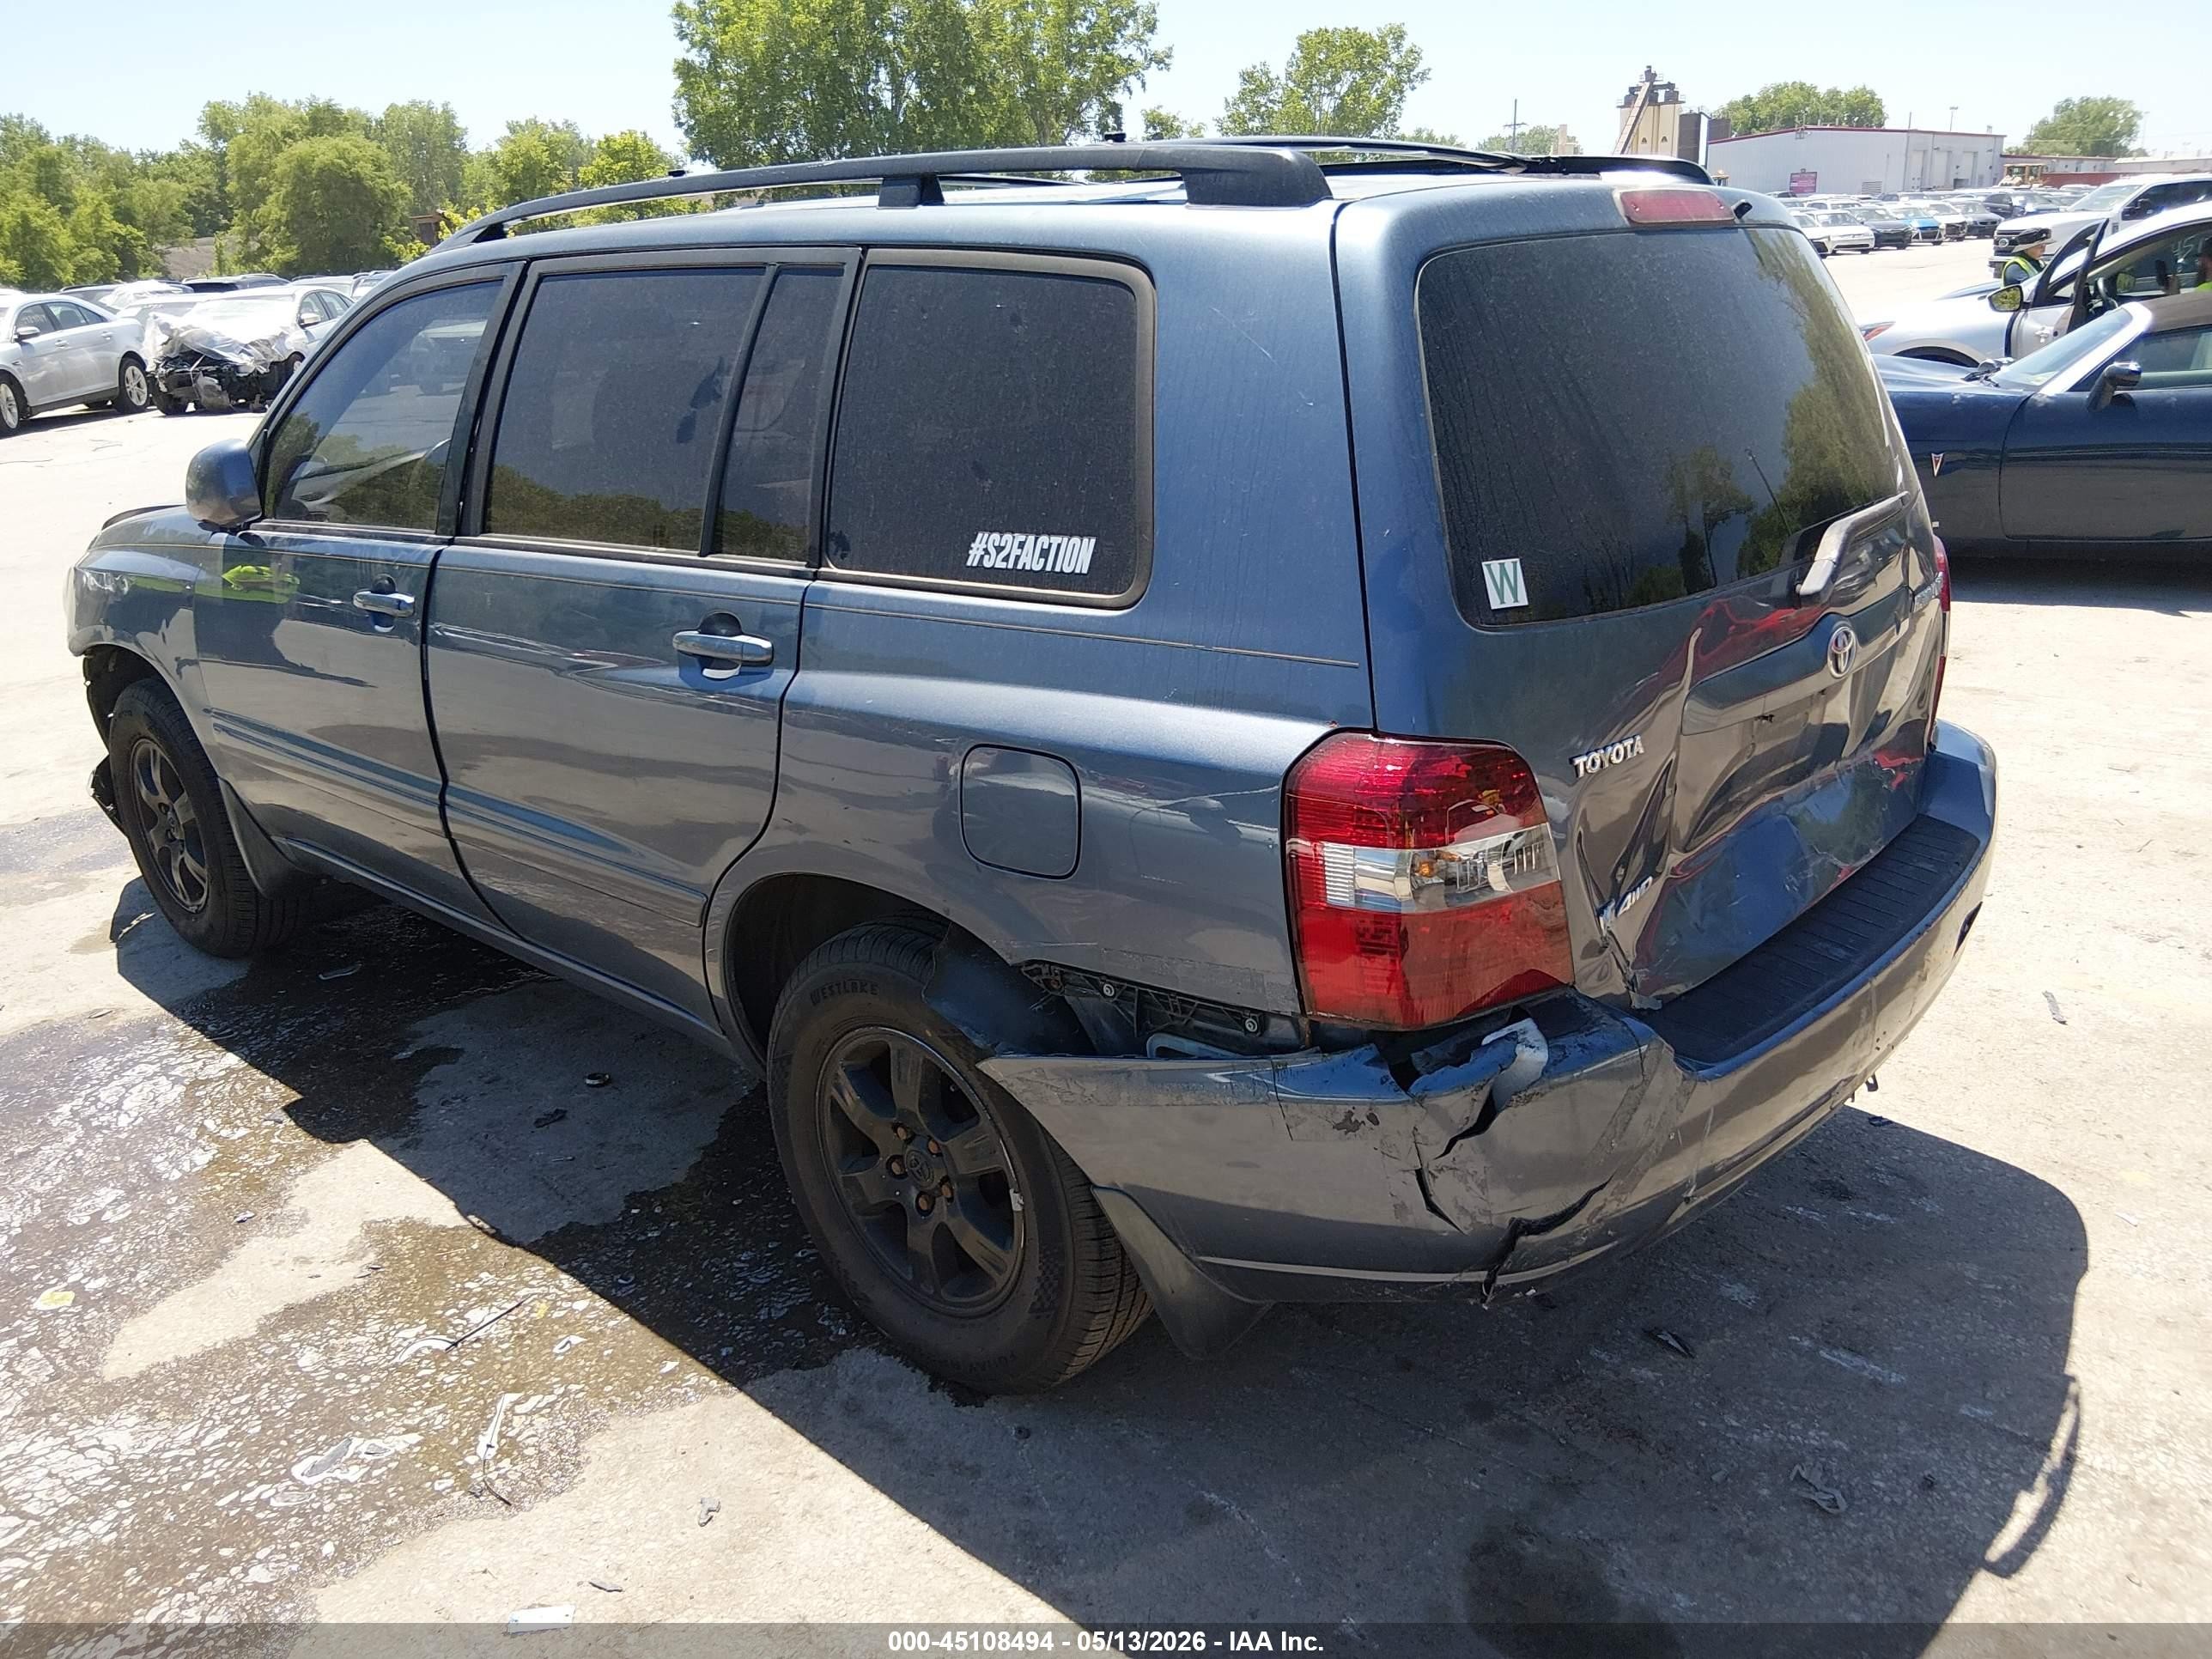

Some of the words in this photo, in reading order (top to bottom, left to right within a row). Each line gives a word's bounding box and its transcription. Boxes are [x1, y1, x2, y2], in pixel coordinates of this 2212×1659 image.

[966, 532, 1096, 574] #S2FACTION
[1485, 561, 1519, 605] W
[1570, 734, 1645, 778] TOYOTA
[810, 979, 879, 1006] WESTLAKE
